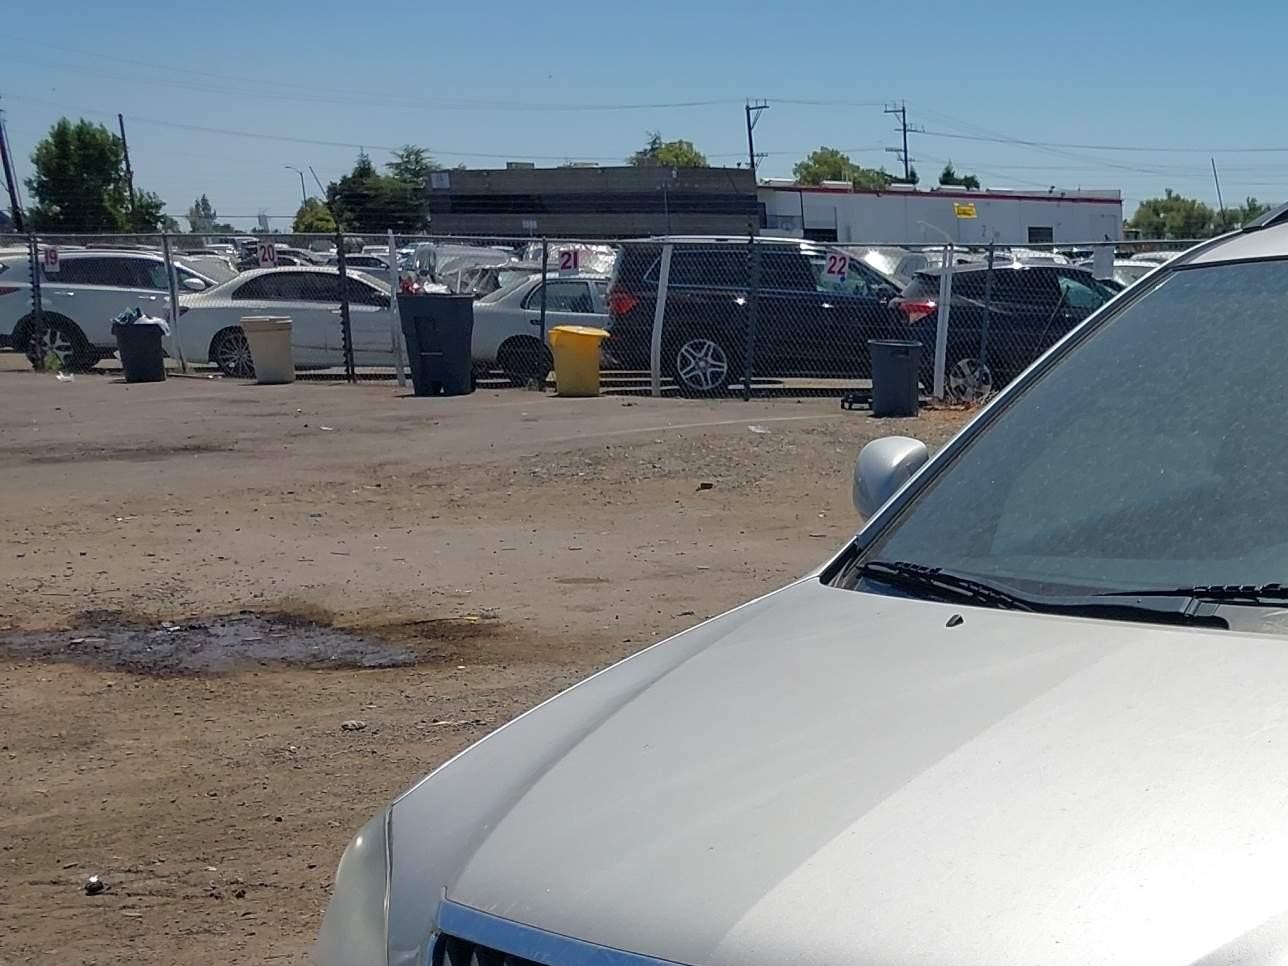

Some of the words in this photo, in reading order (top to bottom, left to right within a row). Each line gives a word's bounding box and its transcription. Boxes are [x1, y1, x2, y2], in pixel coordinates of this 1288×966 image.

[45, 249, 58, 266] 19
[259, 244, 275, 262] 20
[560, 251, 578, 270] 21
[827, 255, 847, 275] 22
